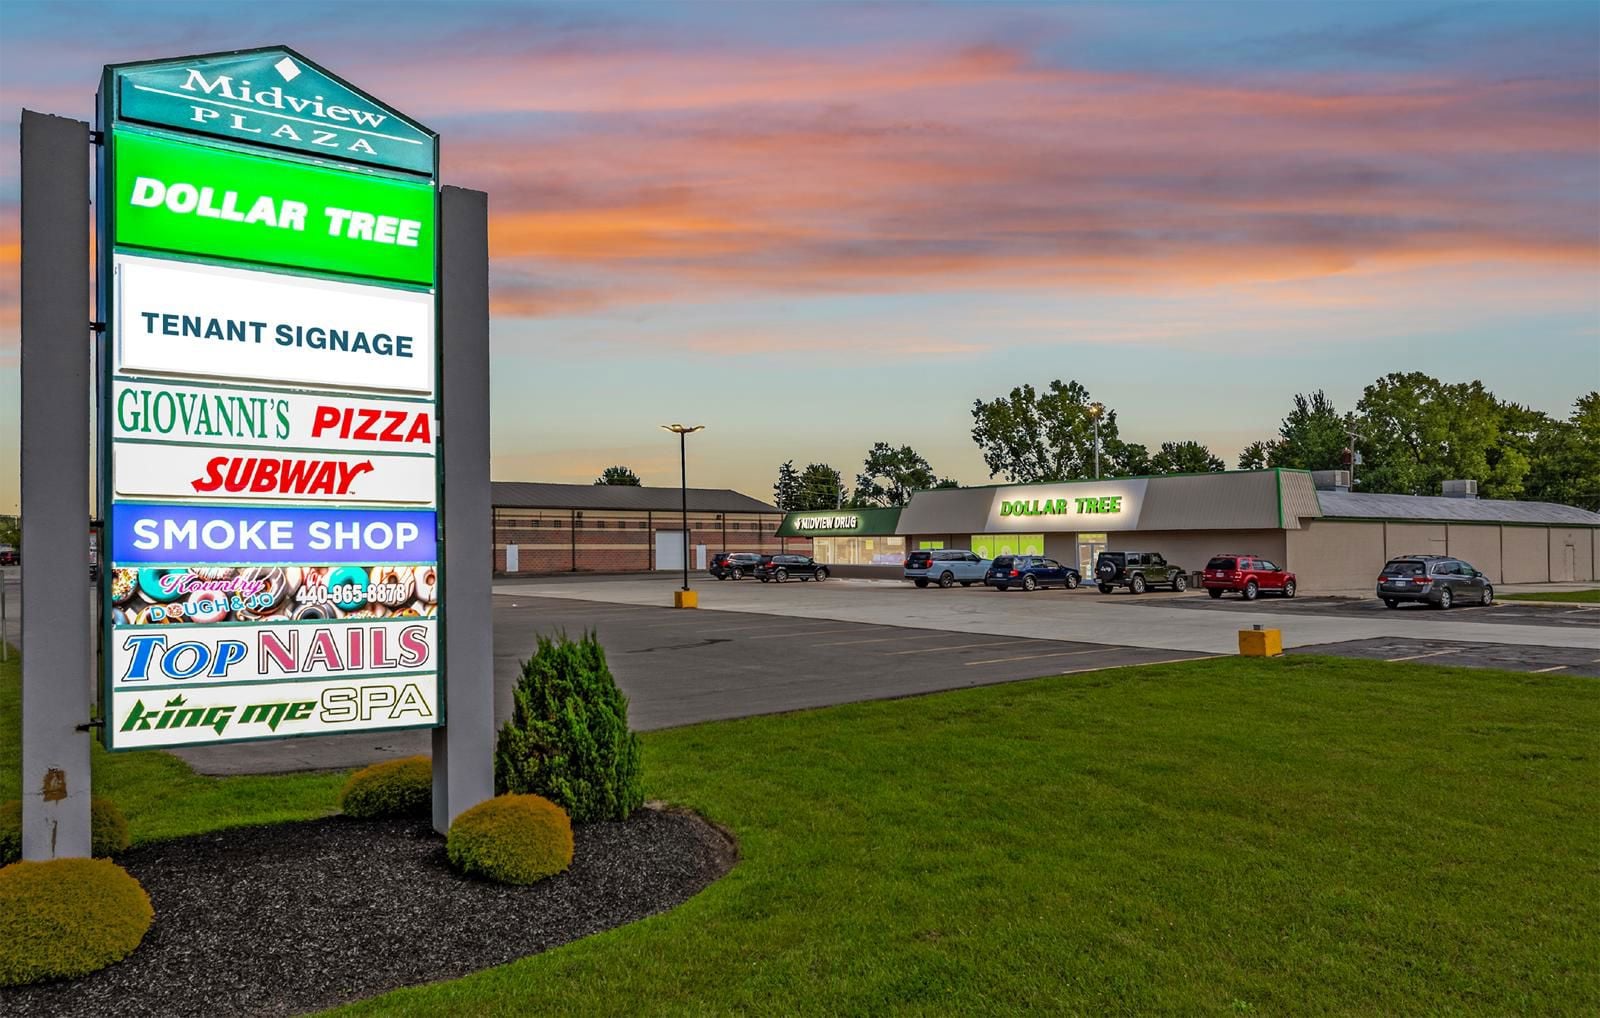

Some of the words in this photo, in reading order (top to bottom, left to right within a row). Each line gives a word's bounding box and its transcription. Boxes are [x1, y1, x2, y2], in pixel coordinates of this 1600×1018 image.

[180, 69, 387, 128] Midview
[190, 106, 377, 155] PLAZA
[130, 177, 308, 231] DOLLAR
[324, 207, 421, 247] TREE
[141, 312, 267, 343] TENANT
[275, 324, 413, 358] SIGNAGE
[117, 388, 290, 440] GIOVANNI'S
[311, 406, 431, 443] PIZZA
[191, 456, 374, 494] SUBWAY
[801, 517, 834, 529] MIDVIEW
[834, 515, 857, 528] DRUG
[1000, 498, 1067, 516] DOLLAR
[1075, 496, 1122, 514] TREE
[133, 519, 294, 550] SMOKE
[308, 522, 419, 550] SHOP
[296, 583, 406, 604] 440-865-8878
[257, 625, 429, 675] NAILS
[238, 700, 318, 732] me
[320, 684, 432, 723] SPA
